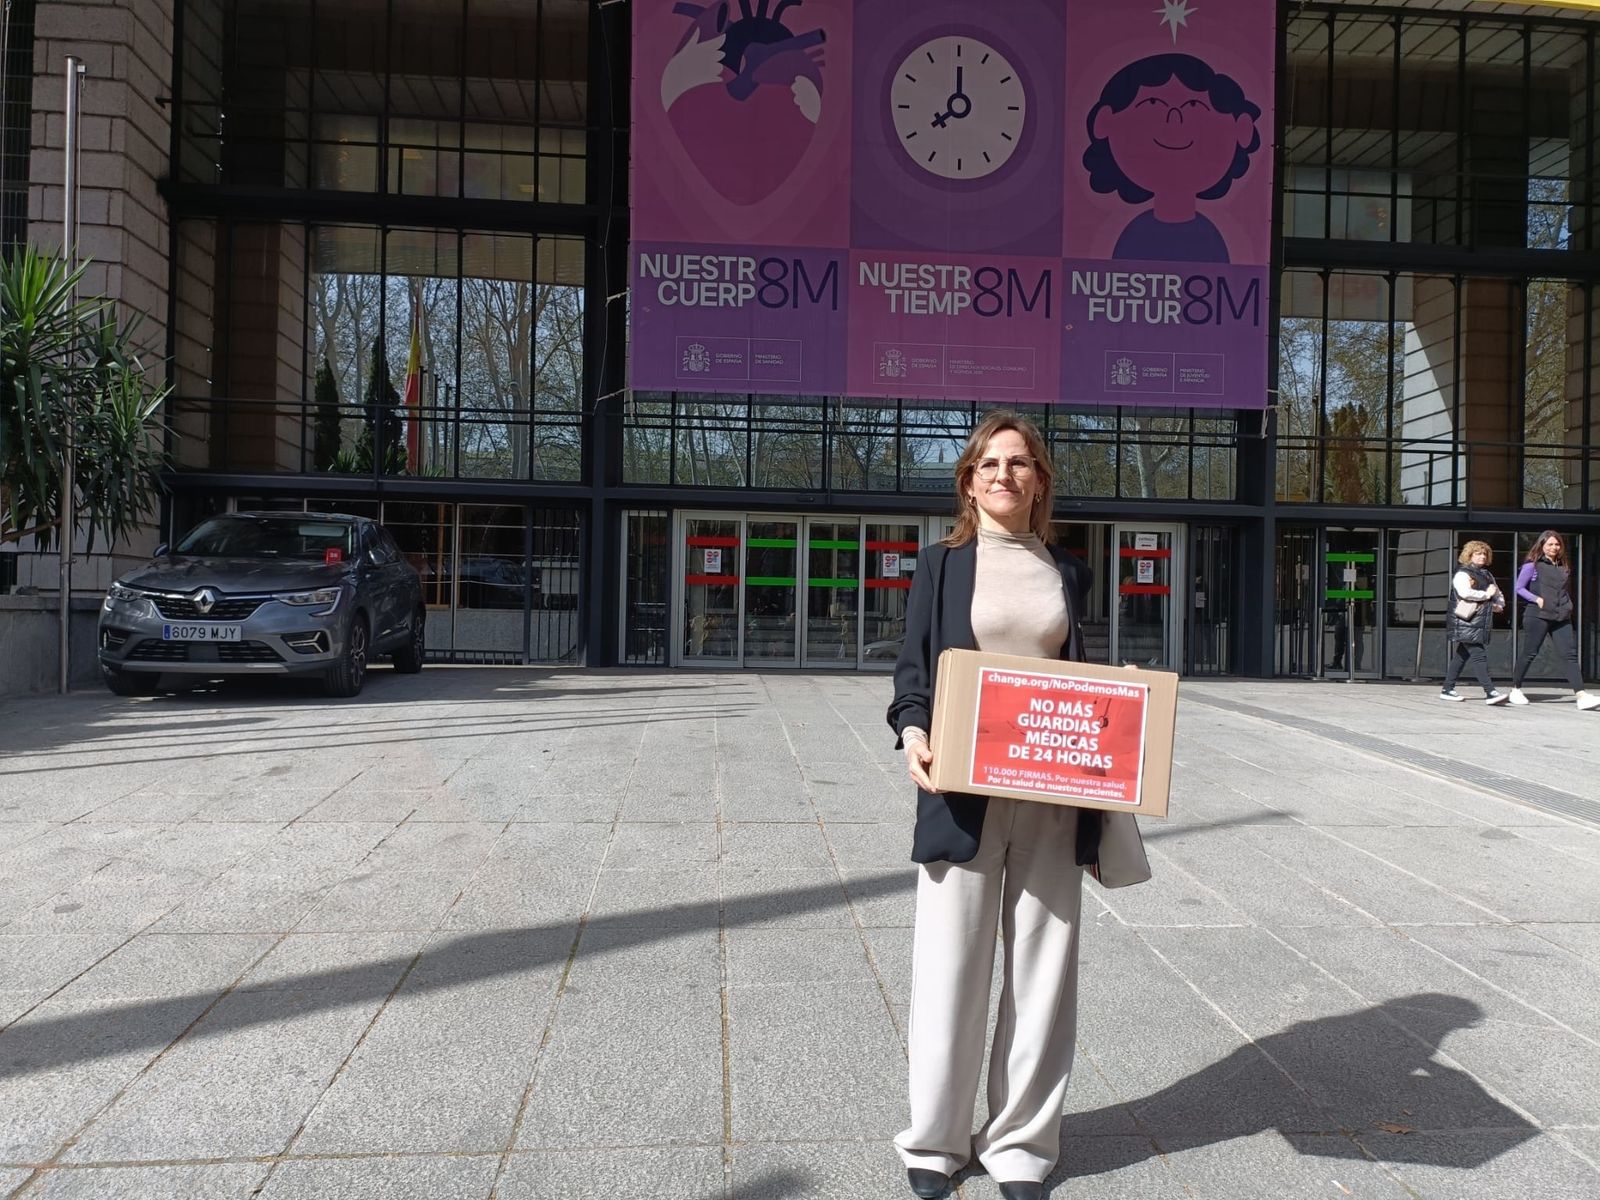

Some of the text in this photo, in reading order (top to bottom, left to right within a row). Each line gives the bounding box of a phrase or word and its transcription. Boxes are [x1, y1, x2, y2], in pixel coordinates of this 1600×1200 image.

[639, 253, 756, 281] NUESTR
[859, 261, 971, 290] NUESTR
[657, 280, 756, 307] CUERP
[757, 257, 838, 311] 8M
[972, 266, 1052, 319] 8M
[1071, 270, 1182, 298] NUESTR
[884, 289, 971, 315] TIEMP
[1088, 298, 1181, 324] FUTUR
[1182, 275, 1260, 327] 8M
[172, 626, 206, 639] 6079
[211, 626, 236, 639] MJY
[988, 672, 1140, 698] change.org/NoPodemosMas
[1030, 698, 1094, 718] NO MÁS
[1017, 713, 1101, 734] GUARDIAS
[1025, 728, 1099, 751] MÉDICAS
[1008, 744, 1113, 769] DE 24 HORAS
[983, 766, 1127, 790] 110.000 FIRMAS. Por nuestra salud.
[987, 775, 1125, 798] Por la salud de nuestros pacientes.
